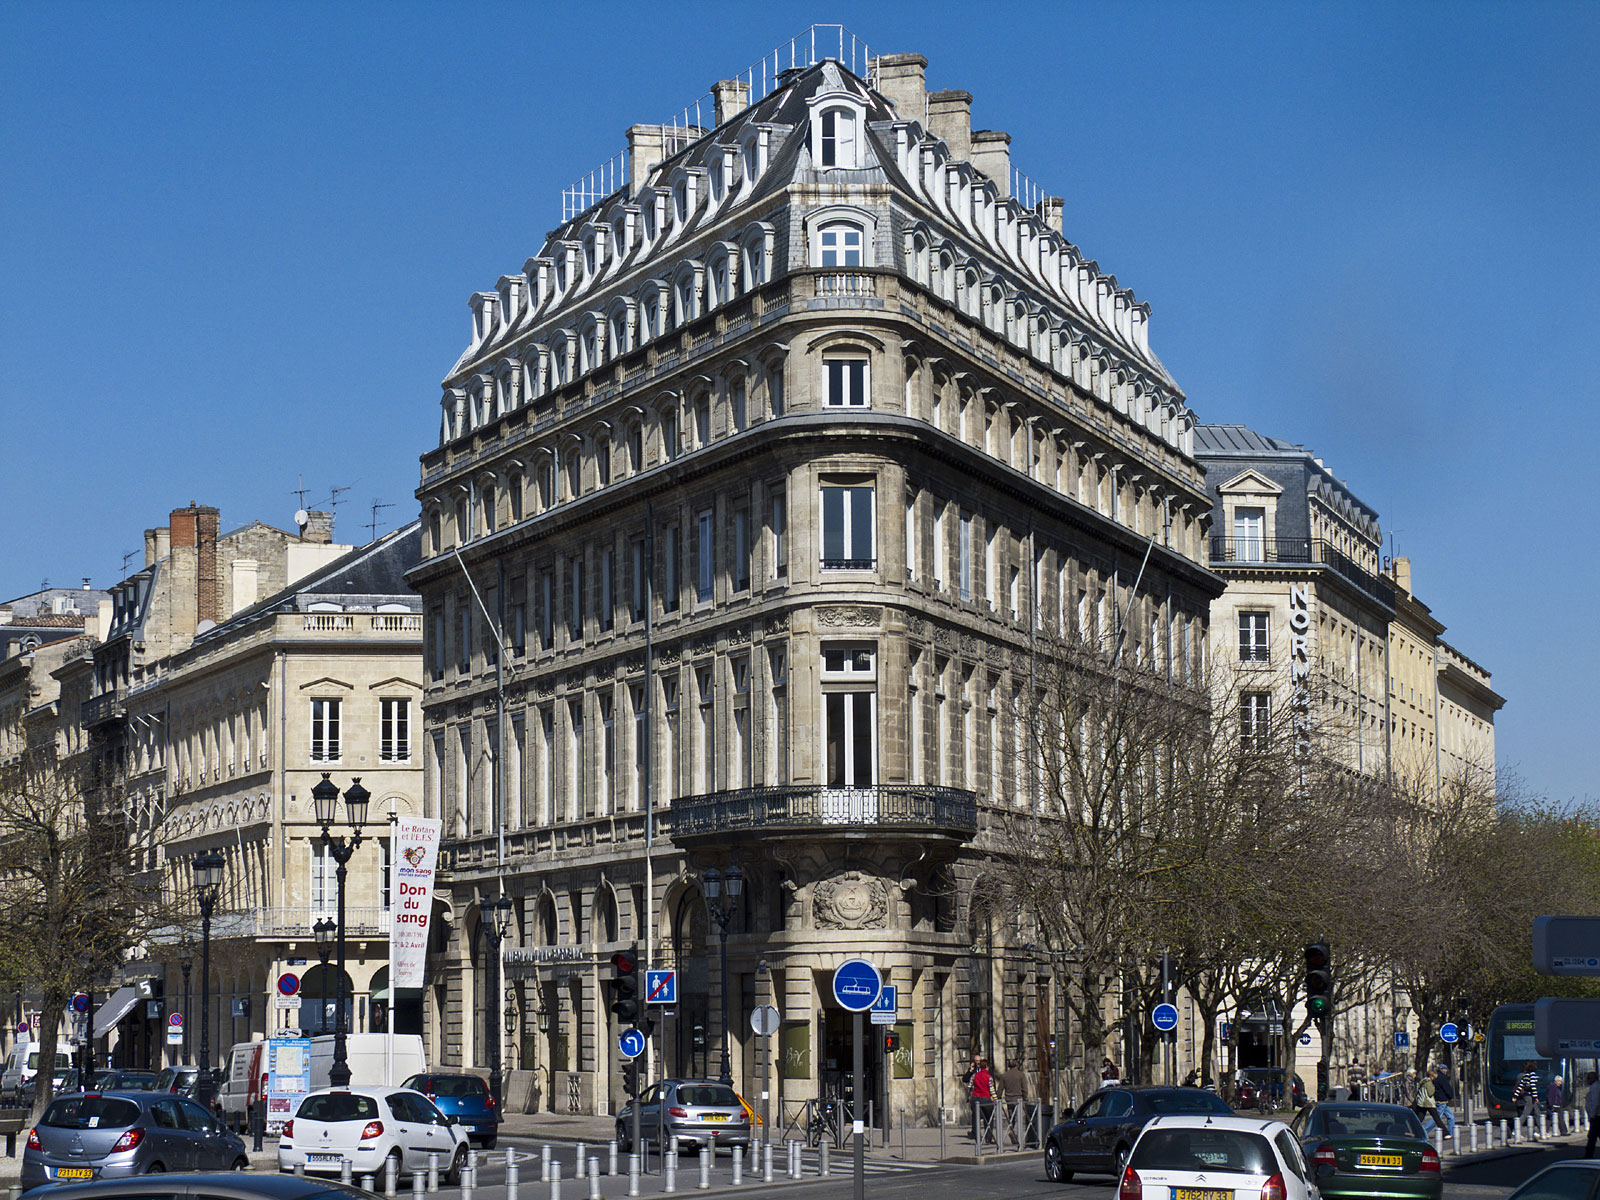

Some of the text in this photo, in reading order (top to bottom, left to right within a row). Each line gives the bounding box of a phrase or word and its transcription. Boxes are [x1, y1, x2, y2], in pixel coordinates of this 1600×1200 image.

[401, 824, 435, 836] Le Rotary
[415, 868, 432, 876] sang
[400, 882, 427, 896] Don
[403, 897, 419, 910] du
[396, 914, 428, 928] sang
[410, 941, 425, 949] Avril
[139, 980, 152, 995] 5
[1180, 1190, 1202, 1200] 3762
[1216, 1191, 1227, 1200] 33
